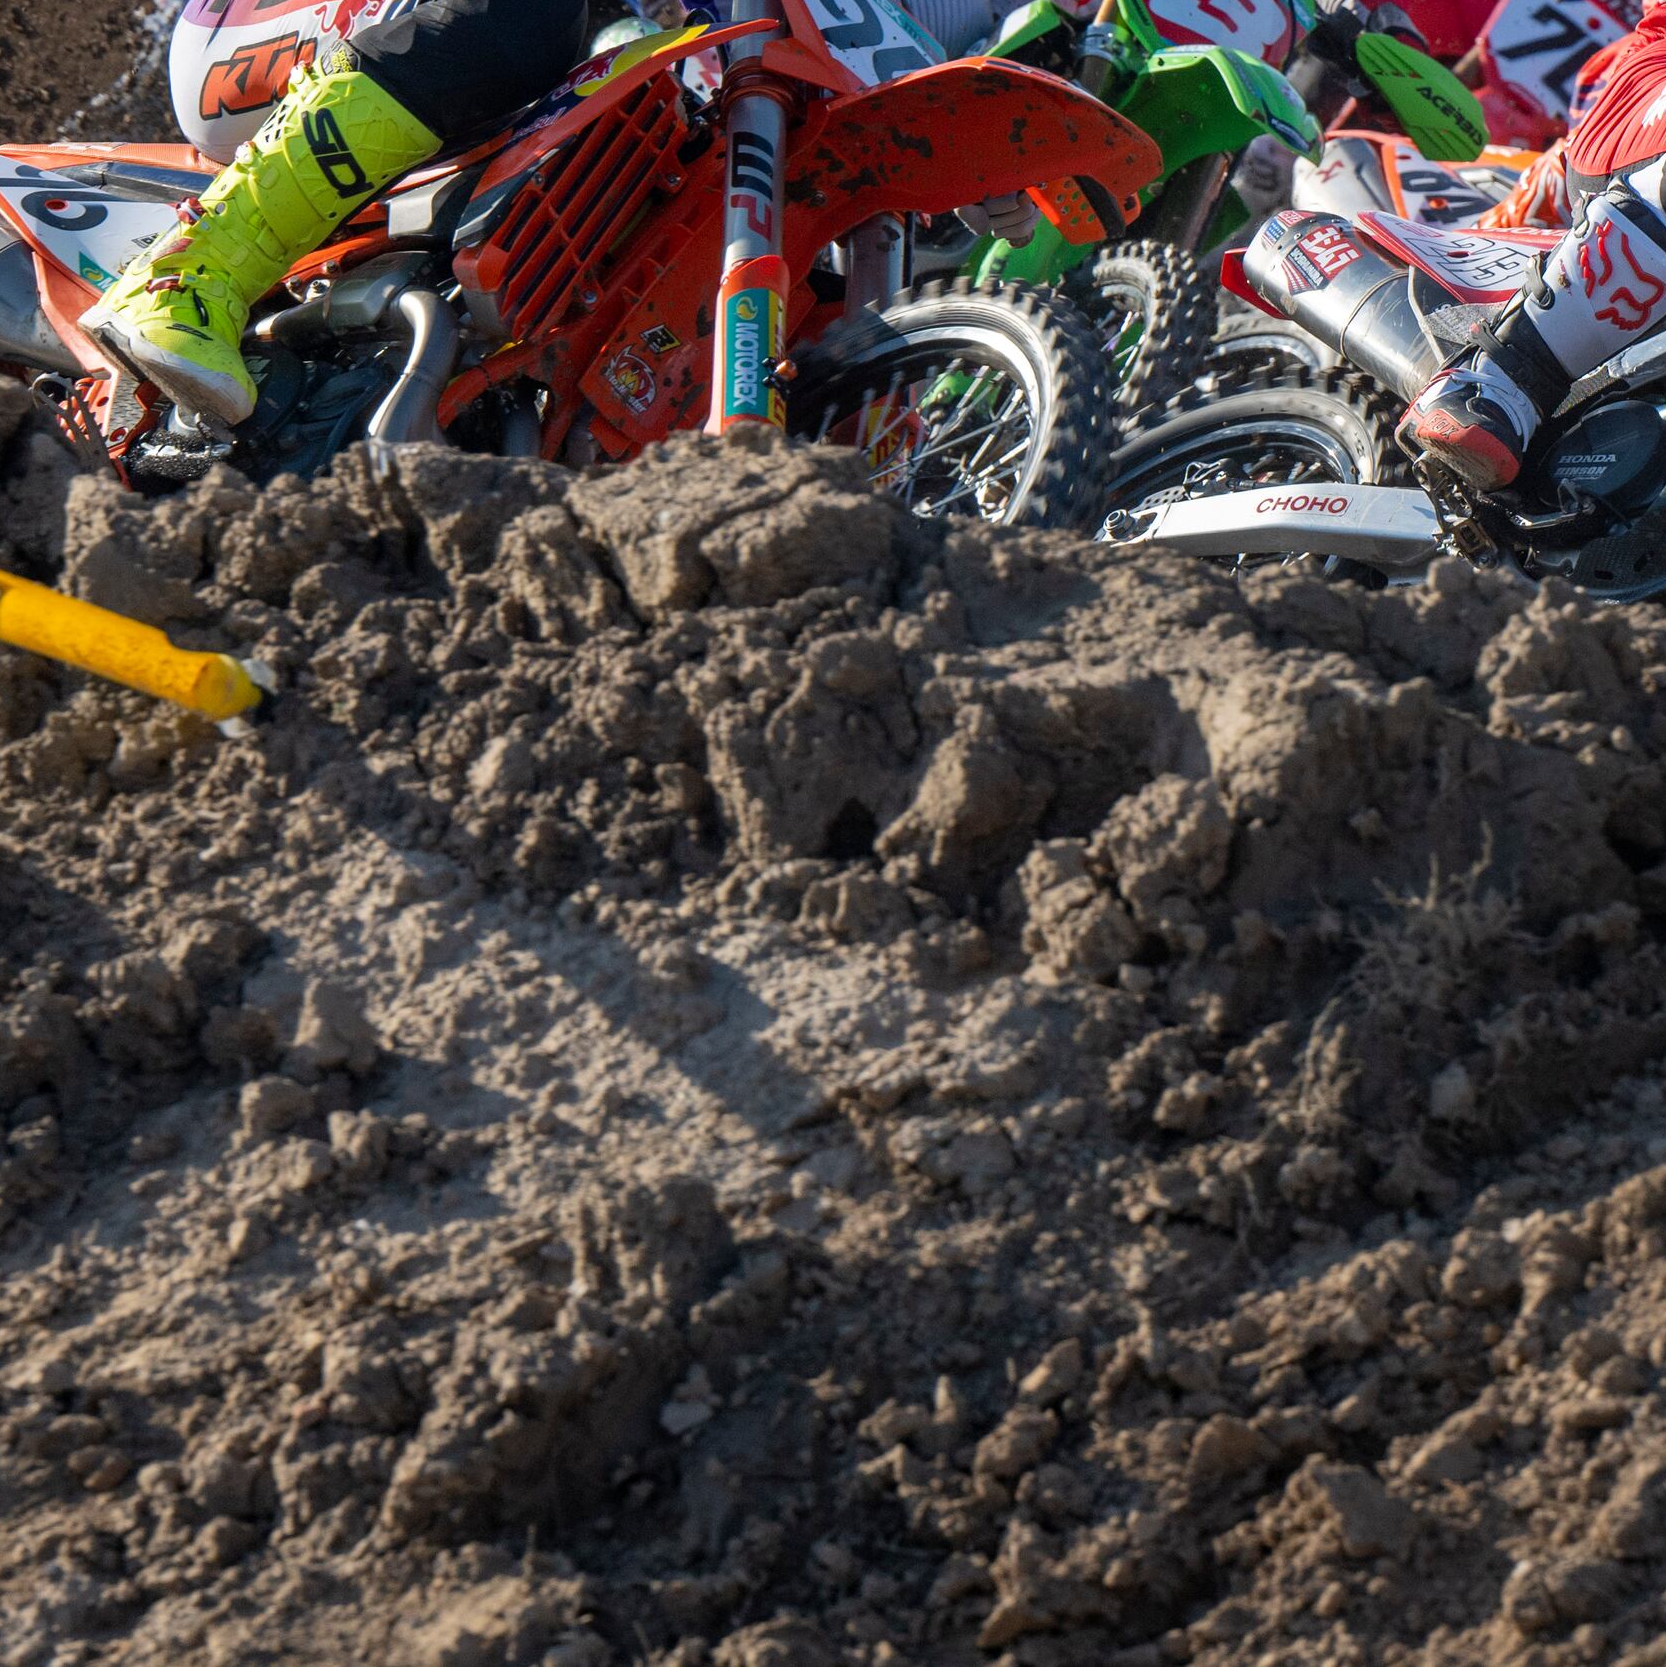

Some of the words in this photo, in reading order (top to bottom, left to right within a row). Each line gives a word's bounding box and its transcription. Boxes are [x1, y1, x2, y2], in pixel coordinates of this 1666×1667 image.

[1417, 84, 1484, 147] ACERBIS
[729, 133, 777, 243] WP
[734, 320, 757, 408] MOTOREX
[1557, 453, 1618, 465] HONDA
[1255, 495, 1349, 515] CHOHO
